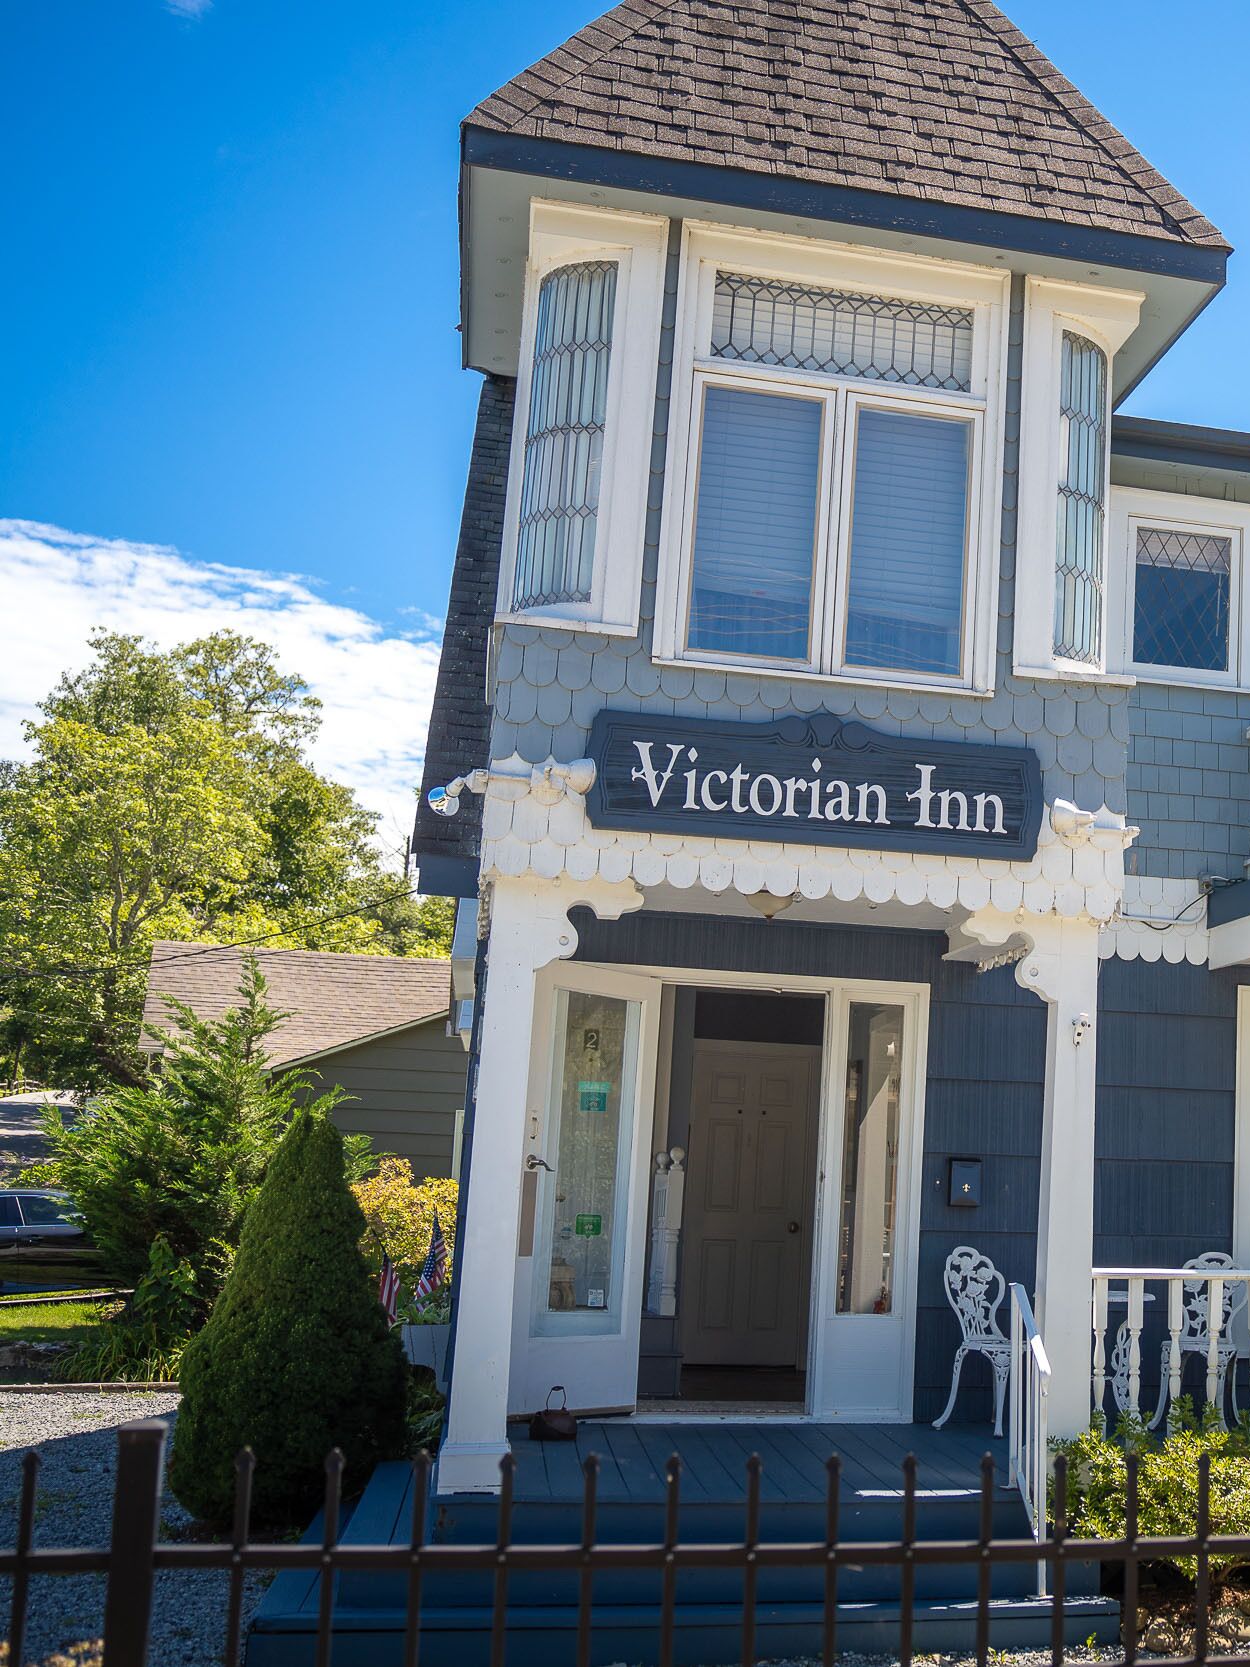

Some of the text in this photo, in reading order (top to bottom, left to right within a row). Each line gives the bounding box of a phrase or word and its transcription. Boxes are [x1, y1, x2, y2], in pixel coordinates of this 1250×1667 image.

[631, 740, 1008, 834] Victorian Inn
[585, 1032, 597, 1048] 2
